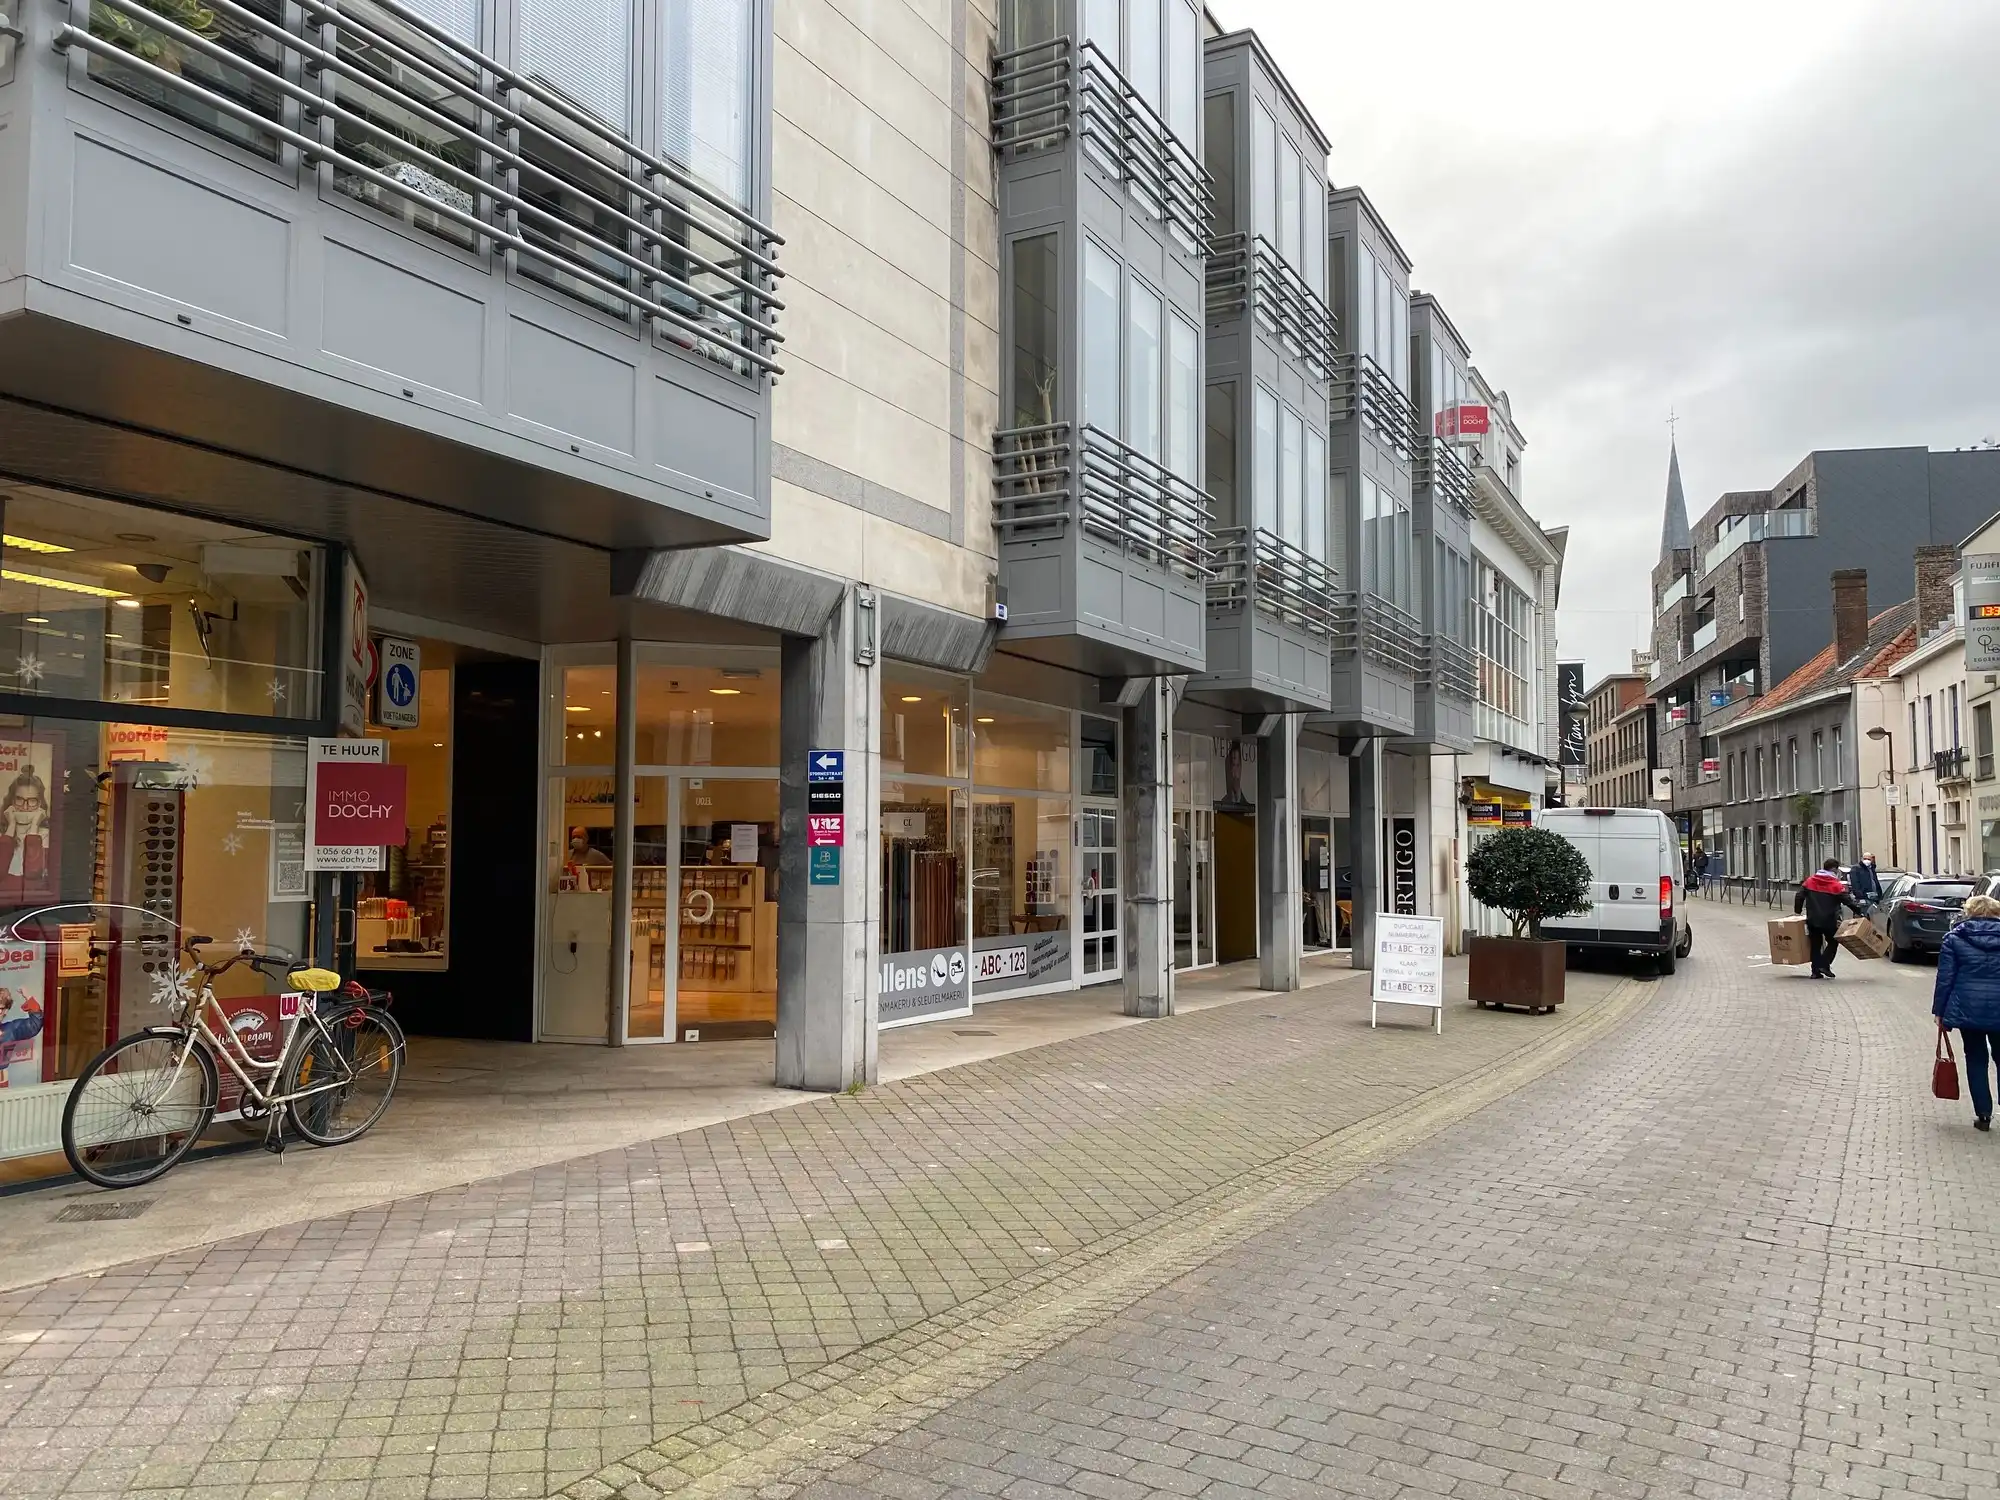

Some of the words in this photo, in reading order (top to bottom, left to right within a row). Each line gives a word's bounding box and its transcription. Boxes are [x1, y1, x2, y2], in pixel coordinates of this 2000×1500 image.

[390, 643, 415, 661] ZONE
[383, 710, 417, 724] VOETGANGERS
[321, 745, 337, 755] TE
[341, 745, 380, 756] HUUR
[328, 790, 370, 802] IMMO
[328, 804, 393, 819] DOCHY
[316, 855, 378, 864] www.dochy.be
[912, 996, 917, 1008] &
[917, 989, 965, 1007] SLEUTELMAKERIJ
